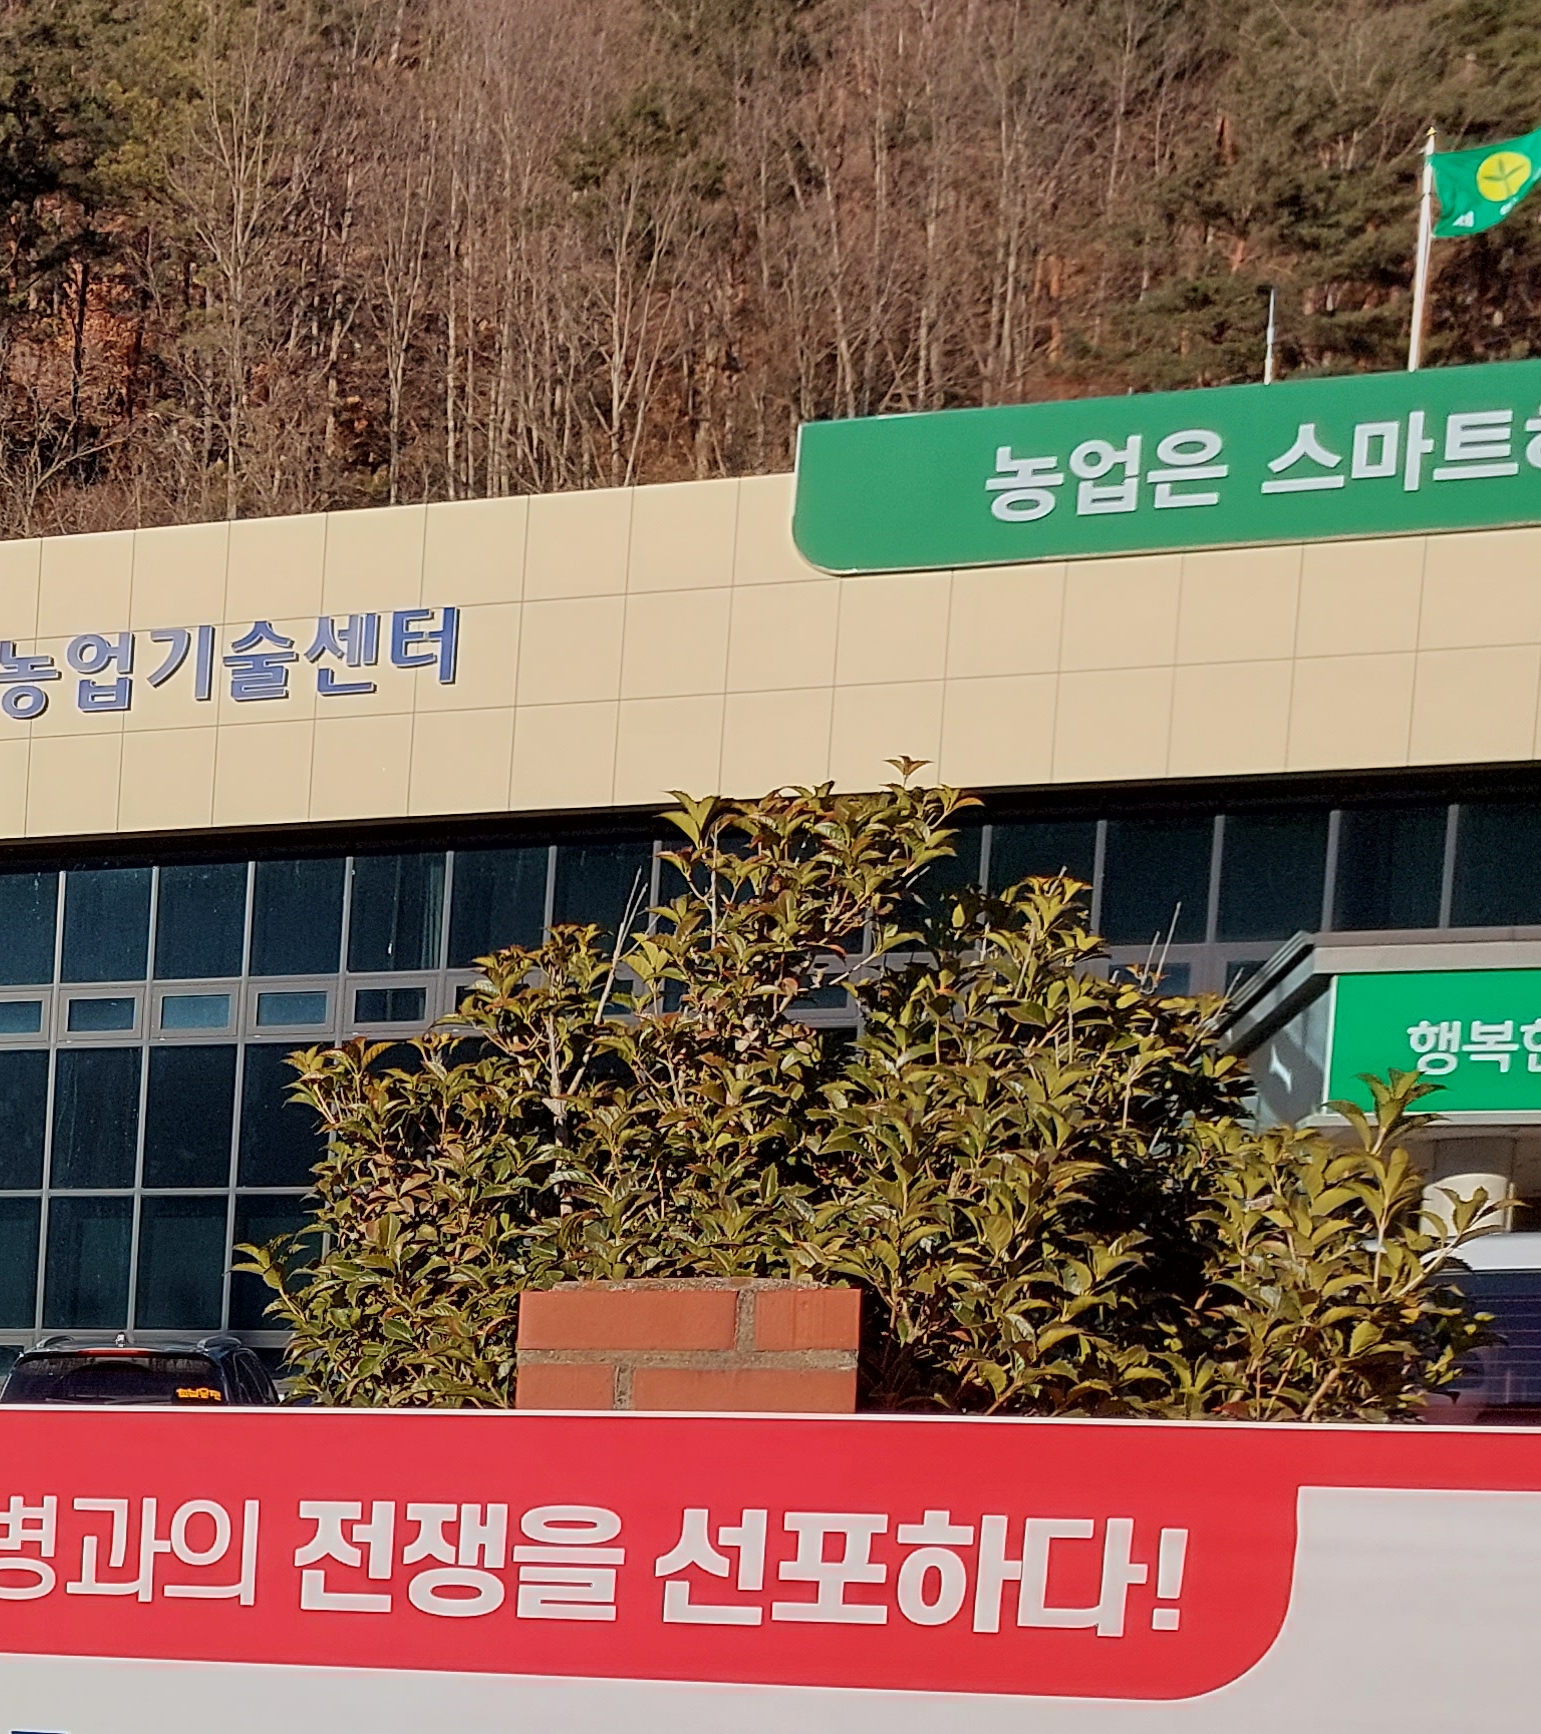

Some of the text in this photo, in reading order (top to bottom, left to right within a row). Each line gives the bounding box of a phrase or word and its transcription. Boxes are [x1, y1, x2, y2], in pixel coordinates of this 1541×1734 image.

[985, 402, 1541, 522] 농업은 스마트
[294, 1500, 626, 1621] 전쟁을
[655, 1508, 1189, 1637] 선포하다!
